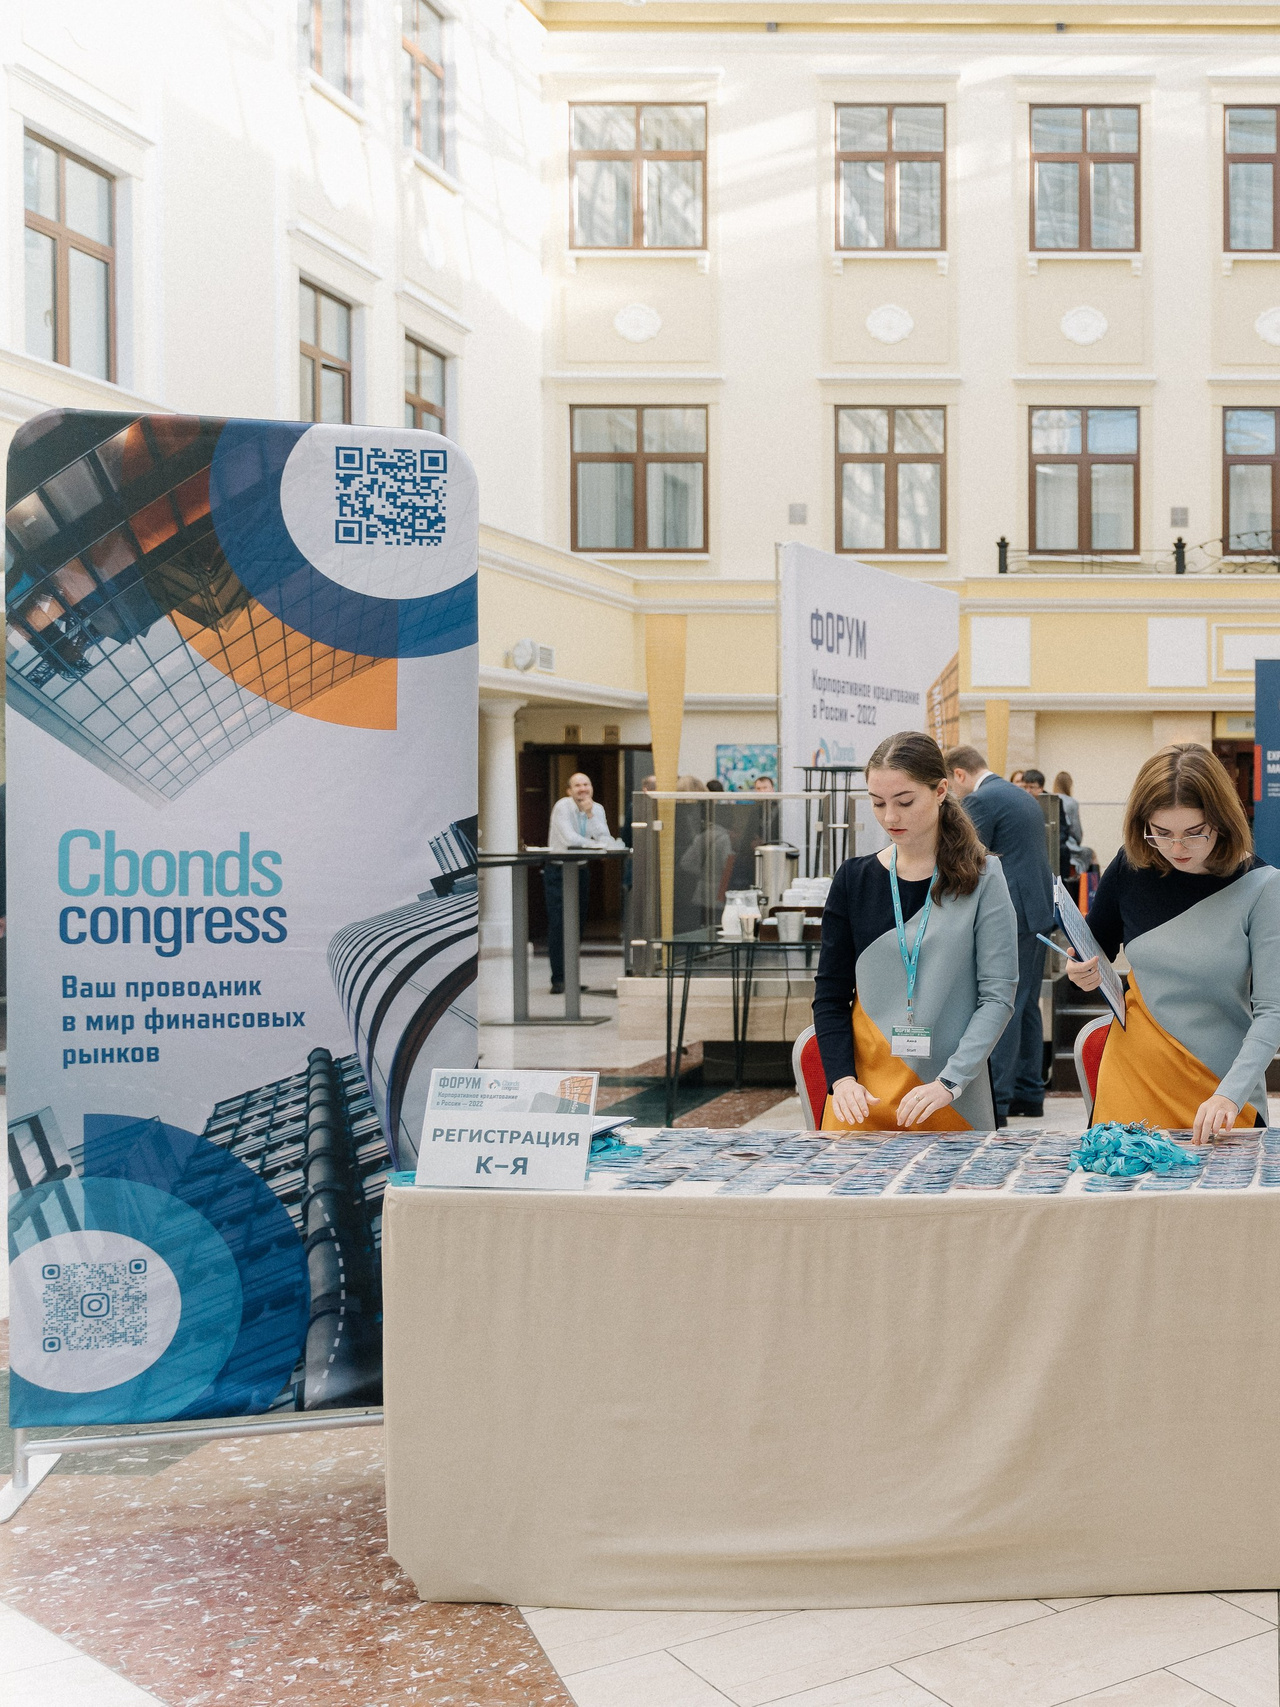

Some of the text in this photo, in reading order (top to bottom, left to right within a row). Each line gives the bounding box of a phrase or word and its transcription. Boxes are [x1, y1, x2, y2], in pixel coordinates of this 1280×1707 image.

[811, 608, 867, 660] ФОРУМ
[812, 669, 920, 706] Корпоративное кредитование
[813, 704, 818, 719] в
[820, 698, 848, 722] России
[858, 704, 877, 726] 2022
[58, 829, 283, 898] Cbonds
[59, 905, 288, 958] congress
[62, 975, 262, 1002] Ваш проводник
[62, 1008, 306, 1037] в мир финансовых
[63, 1045, 160, 1070] рынков
[437, 1091, 479, 1099] Корпоративное
[439, 1076, 482, 1090] ФОРУМ
[431, 1128, 580, 1148] РЕГИСТРАЦИЯ
[475, 1155, 529, 1175] К–Я
